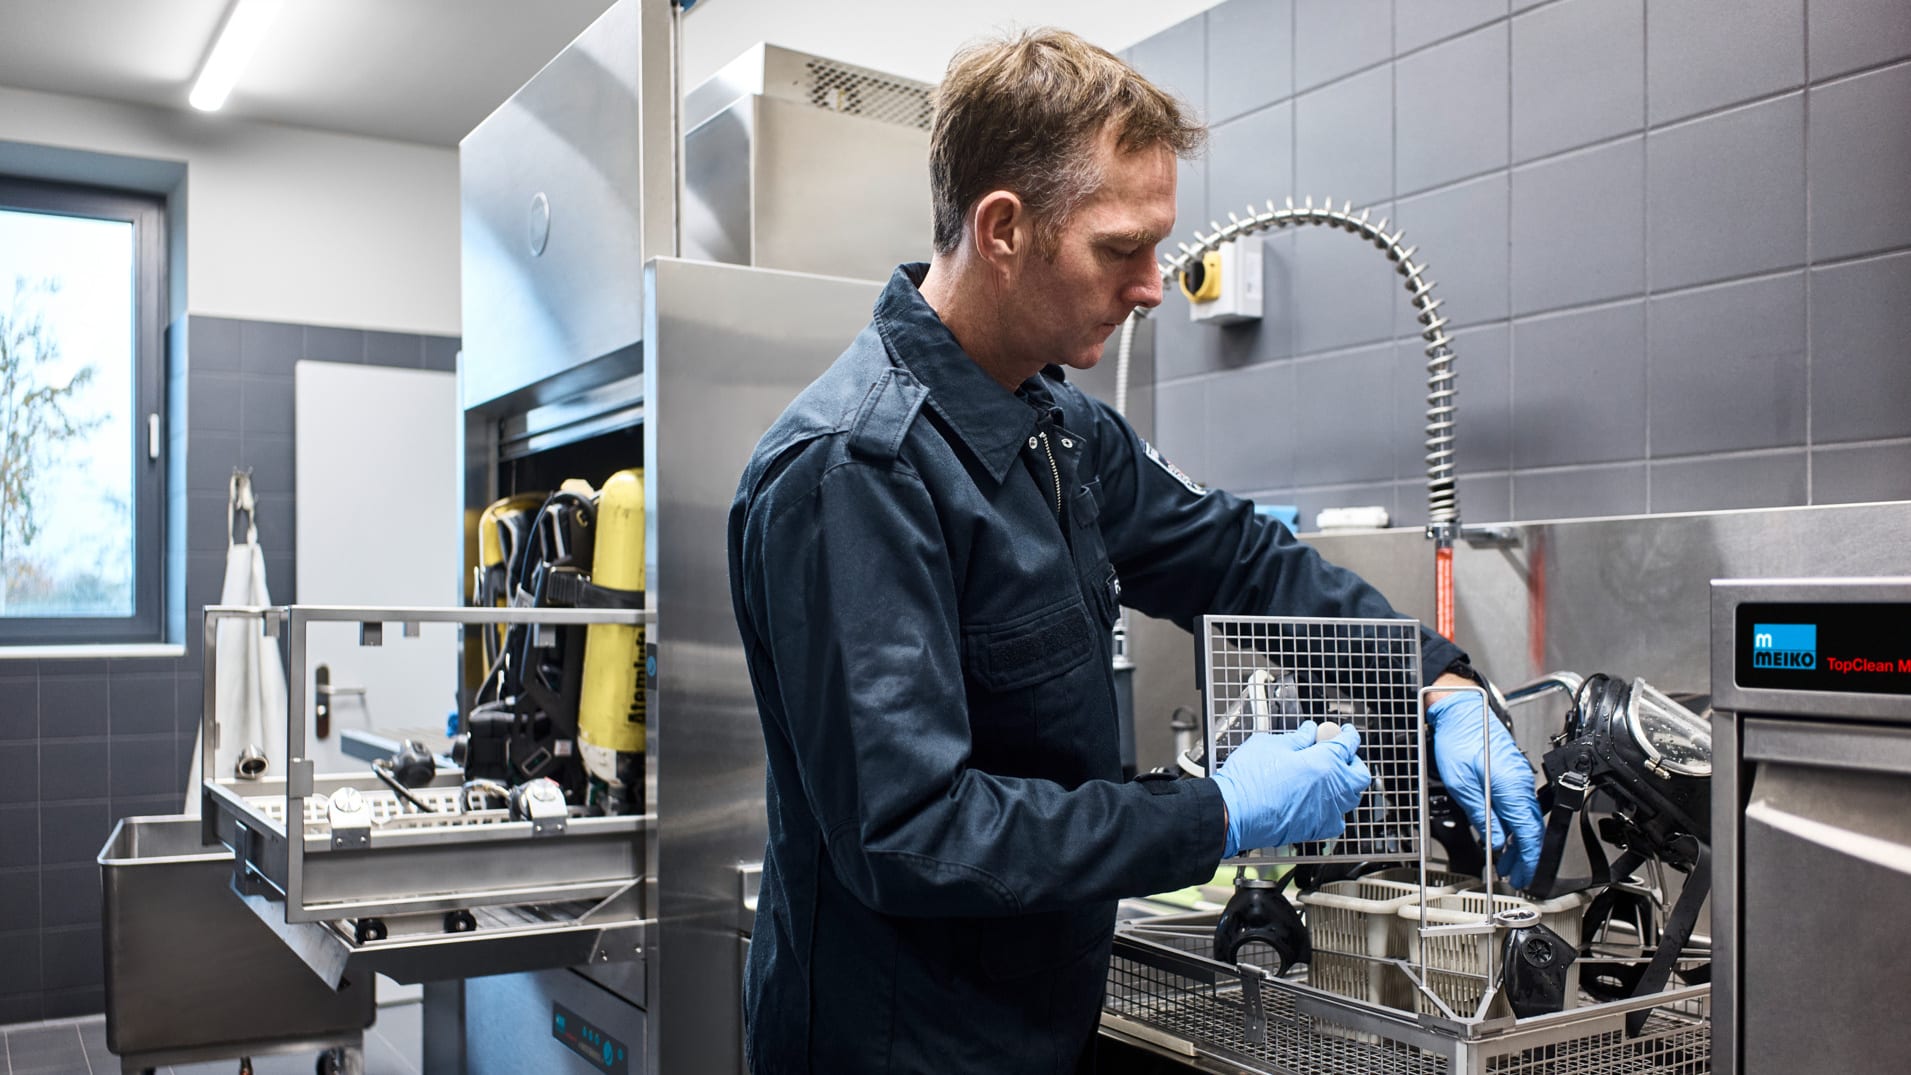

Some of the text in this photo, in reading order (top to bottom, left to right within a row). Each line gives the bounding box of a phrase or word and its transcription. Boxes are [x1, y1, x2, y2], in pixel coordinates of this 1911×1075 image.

[1755, 651, 1814, 667] MEIKO
[1827, 657, 1911, 674] TopClean M
